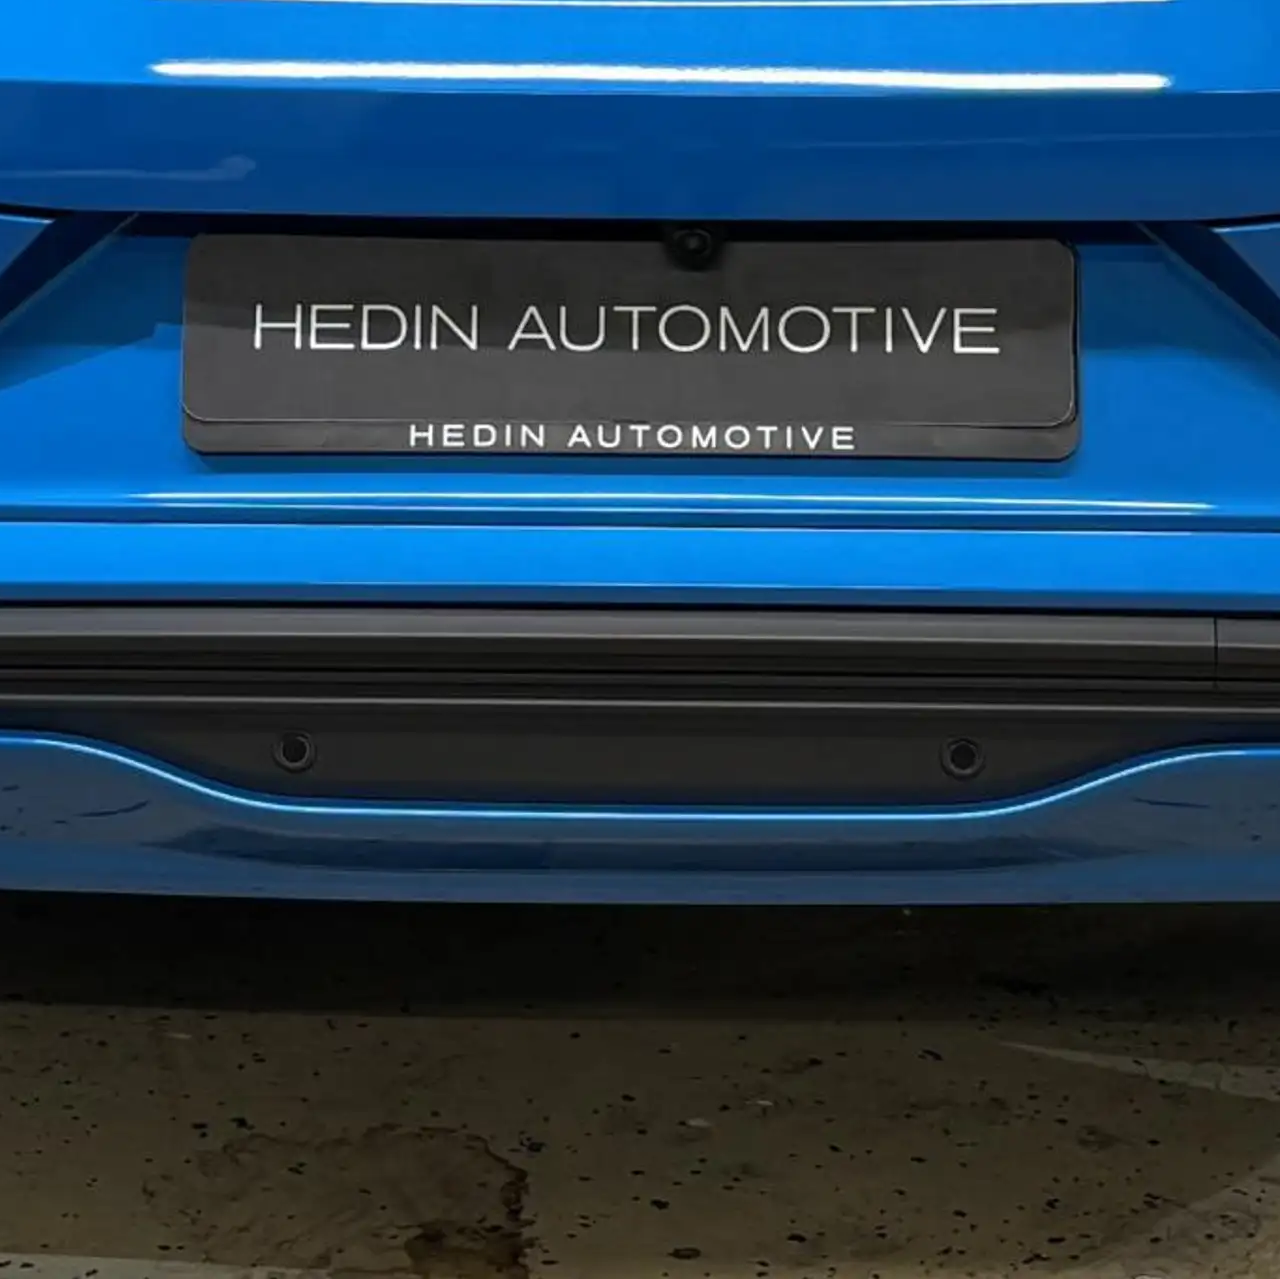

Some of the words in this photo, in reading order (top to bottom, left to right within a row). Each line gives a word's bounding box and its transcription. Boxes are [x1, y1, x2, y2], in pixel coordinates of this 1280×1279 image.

[253, 303, 479, 352] HEDIN
[507, 304, 1001, 355] AUTOMOTIVE
[408, 422, 546, 448] HEDIN
[566, 423, 856, 450] AUTOMOTIVE
